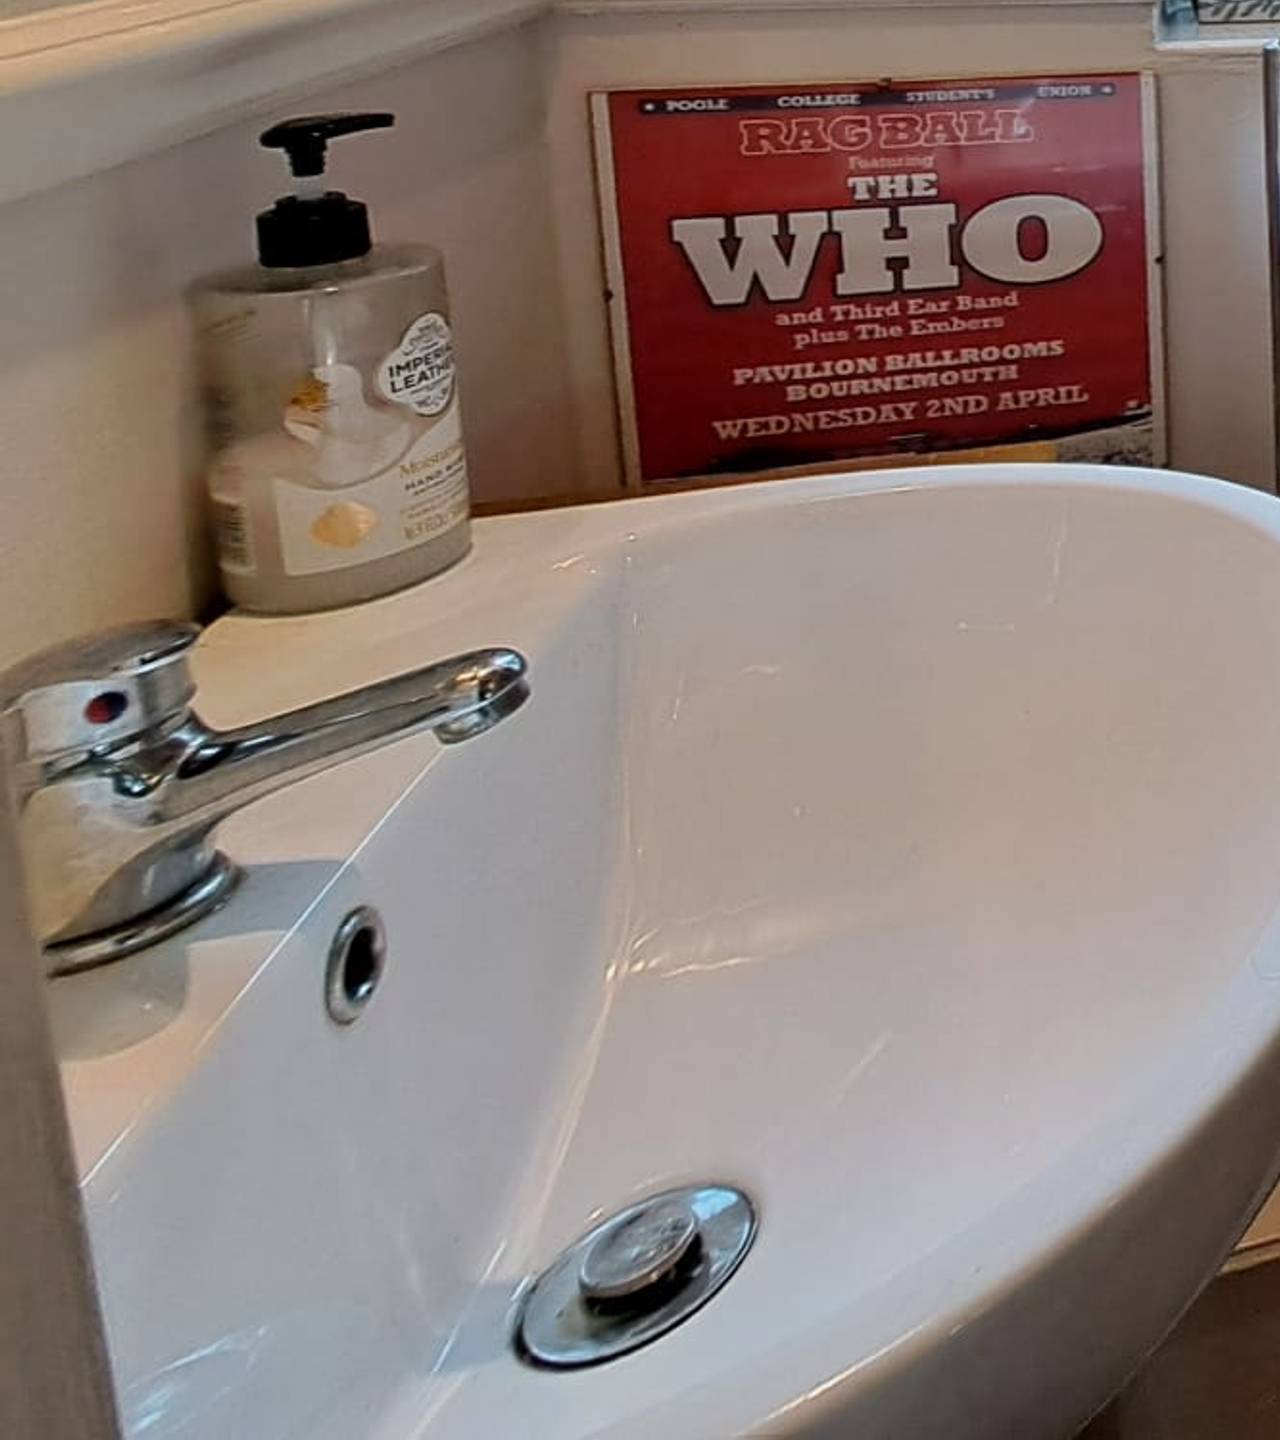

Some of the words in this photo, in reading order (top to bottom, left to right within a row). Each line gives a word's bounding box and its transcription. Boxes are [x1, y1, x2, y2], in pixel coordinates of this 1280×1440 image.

[666, 99, 730, 112] POOLE
[777, 93, 861, 108] COLLEGE
[1036, 85, 1092, 98] UNION
[738, 115, 872, 155] RAG
[877, 109, 1034, 150] BALL
[847, 172, 938, 201] THE
[671, 193, 1103, 305] WHO
[775, 307, 825, 326] and
[829, 301, 901, 322] Third
[906, 297, 950, 315] Ear
[956, 291, 1020, 311] Band
[793, 329, 849, 350] plus
[854, 322, 903, 341] The
[909, 315, 1005, 337] Embers
[733, 357, 878, 386] PAVILION
[884, 339, 1065, 372] BALLROOMS
[785, 364, 1020, 403] BOURNEMOUTH
[711, 401, 919, 441] WEDNESDAY
[925, 394, 989, 419] 2ND
[996, 385, 1090, 412] APRIL
